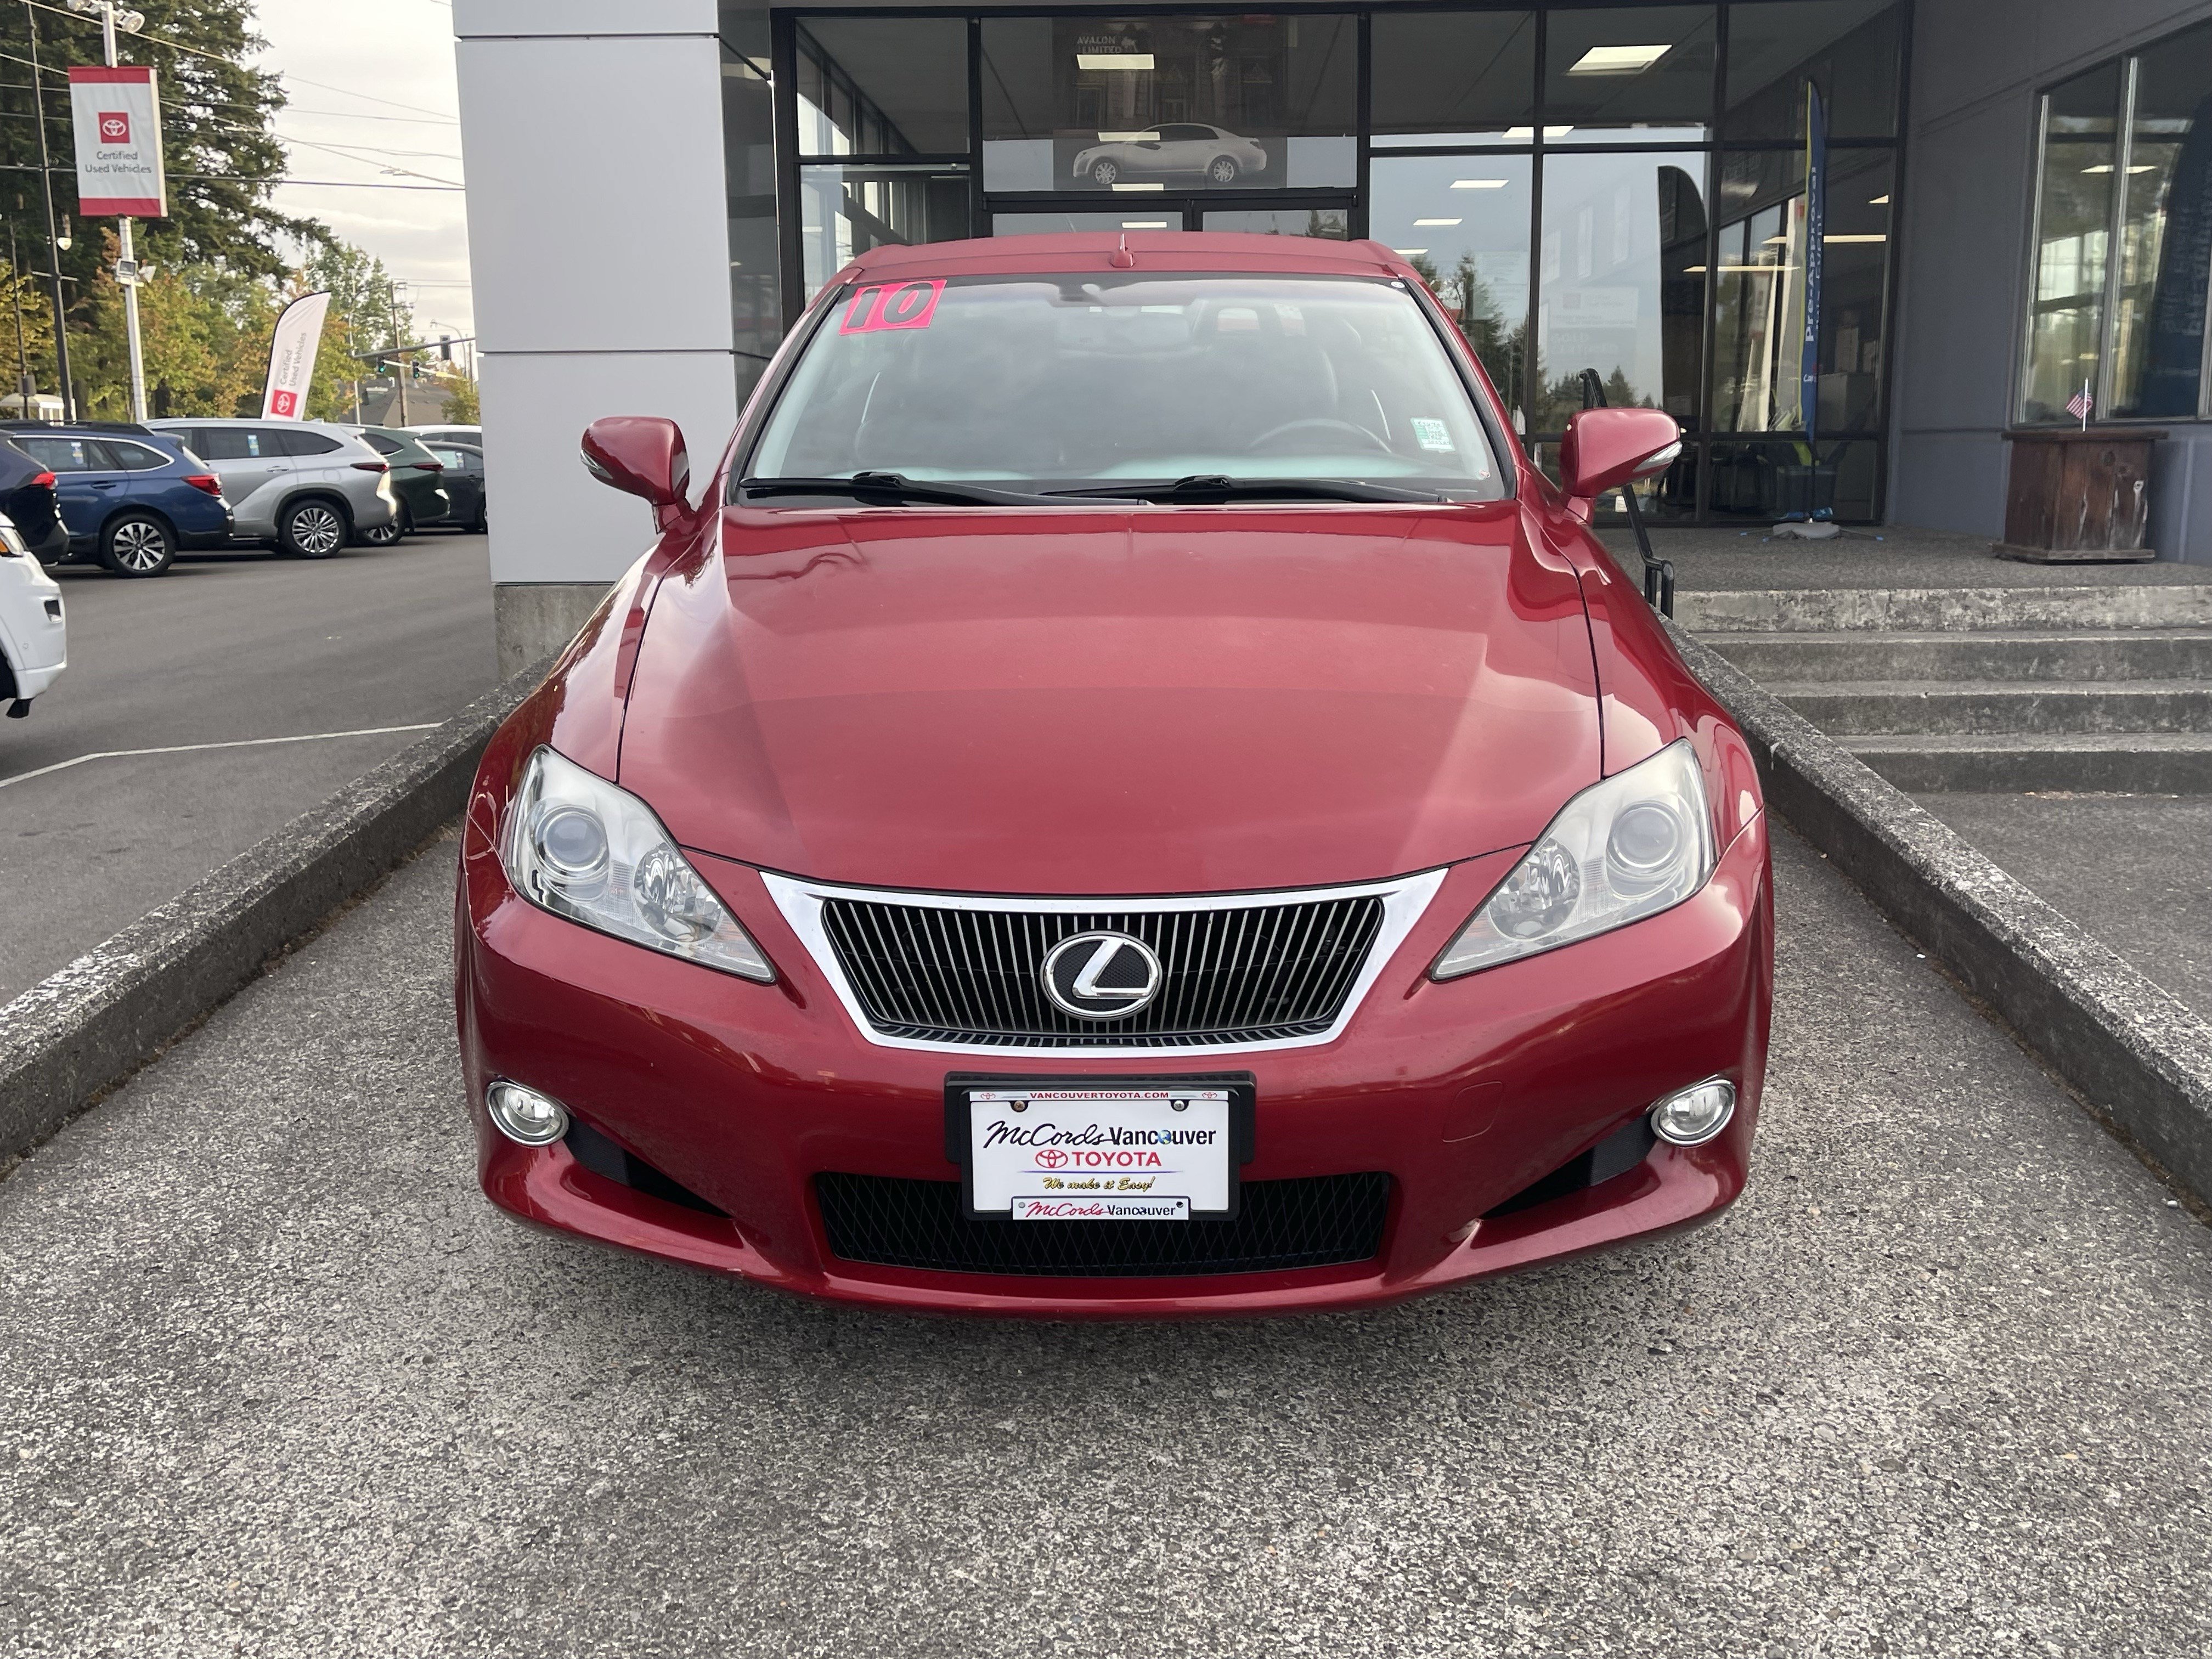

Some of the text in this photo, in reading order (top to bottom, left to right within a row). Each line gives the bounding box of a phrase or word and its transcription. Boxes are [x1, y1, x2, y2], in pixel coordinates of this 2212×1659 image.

[1077, 36, 1115, 44] AVALON
[97, 151, 138, 160] Certified
[85, 164, 151, 173] Used Vehicles
[847, 283, 933, 328] 10
[280, 349, 292, 385] Certified
[289, 332, 306, 386] Used Vehicles
[983, 1120, 1216, 1149] McCords Vancouver
[1072, 1152, 1162, 1167] TOYOTA
[1043, 1176, 1156, 1192] We make it Easy!
[1025, 1201, 1176, 1218] McCords Vancouver
